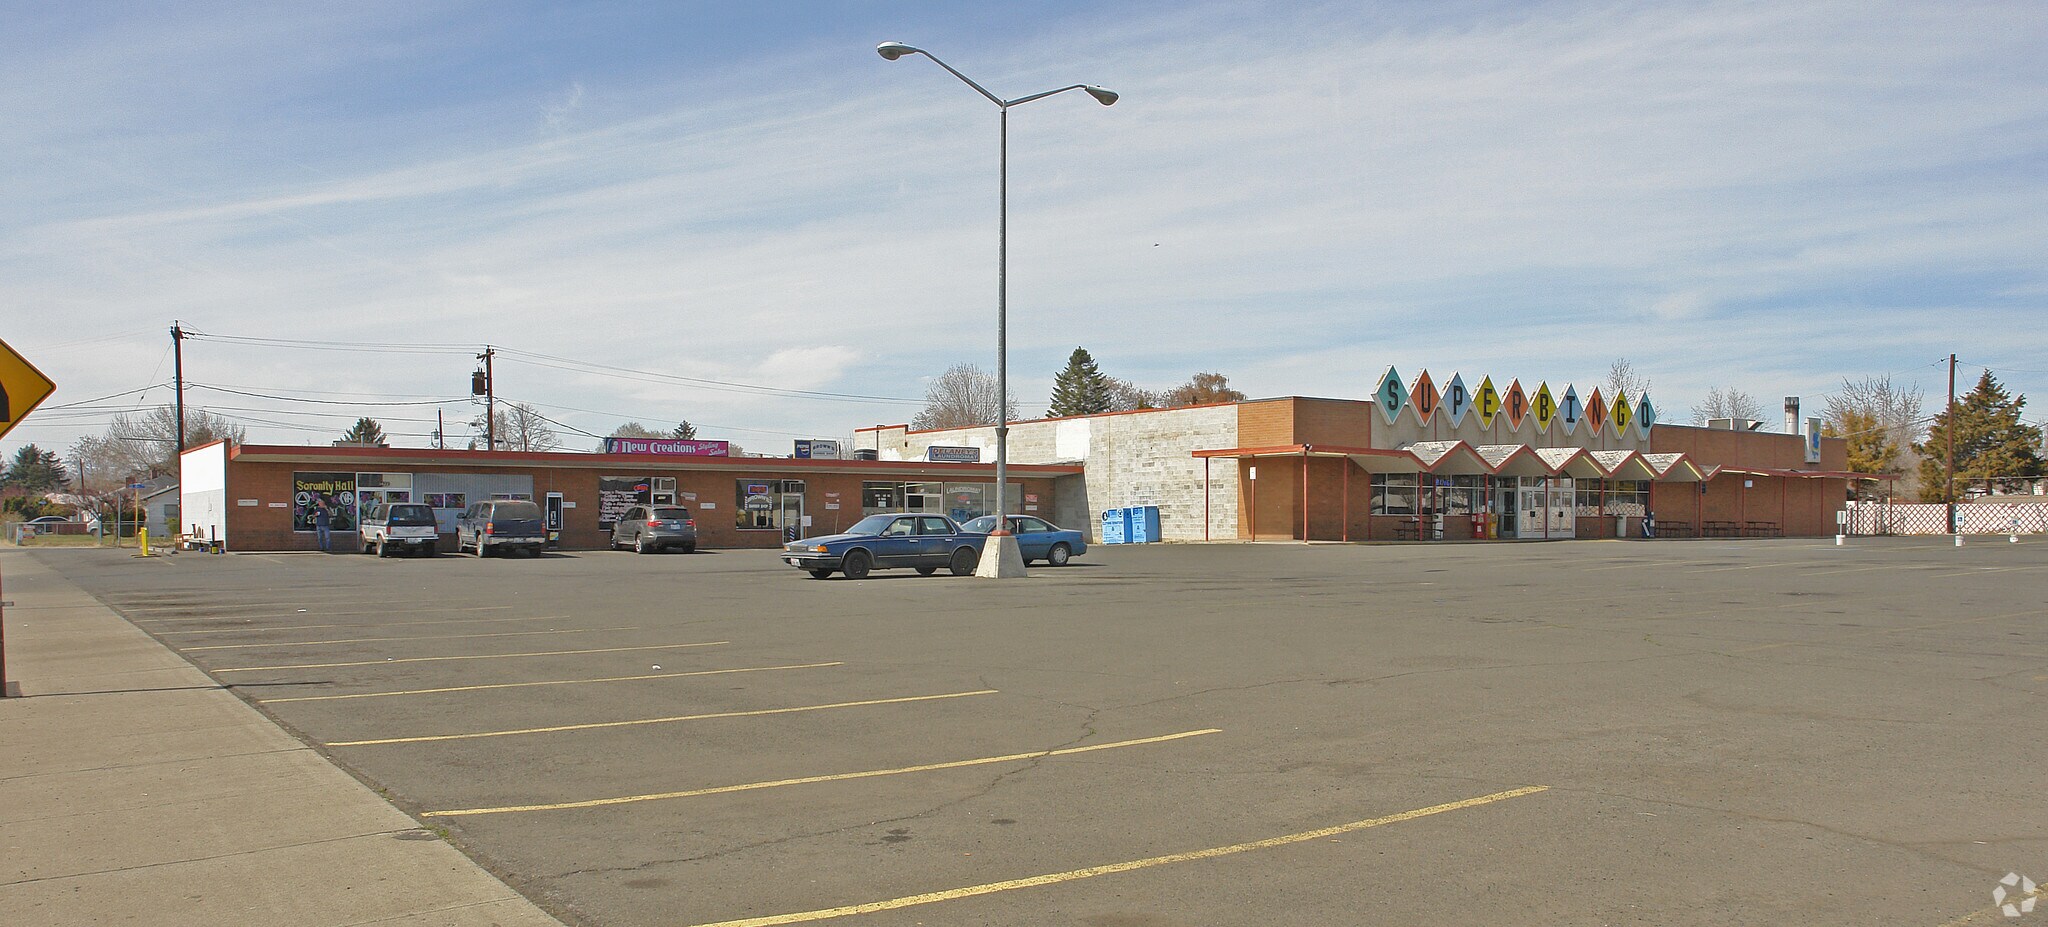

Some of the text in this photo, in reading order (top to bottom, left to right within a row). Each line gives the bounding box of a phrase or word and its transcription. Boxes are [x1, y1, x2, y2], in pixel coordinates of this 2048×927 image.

[621, 441, 696, 454] New Creations
[335, 480, 354, 491] Hall
